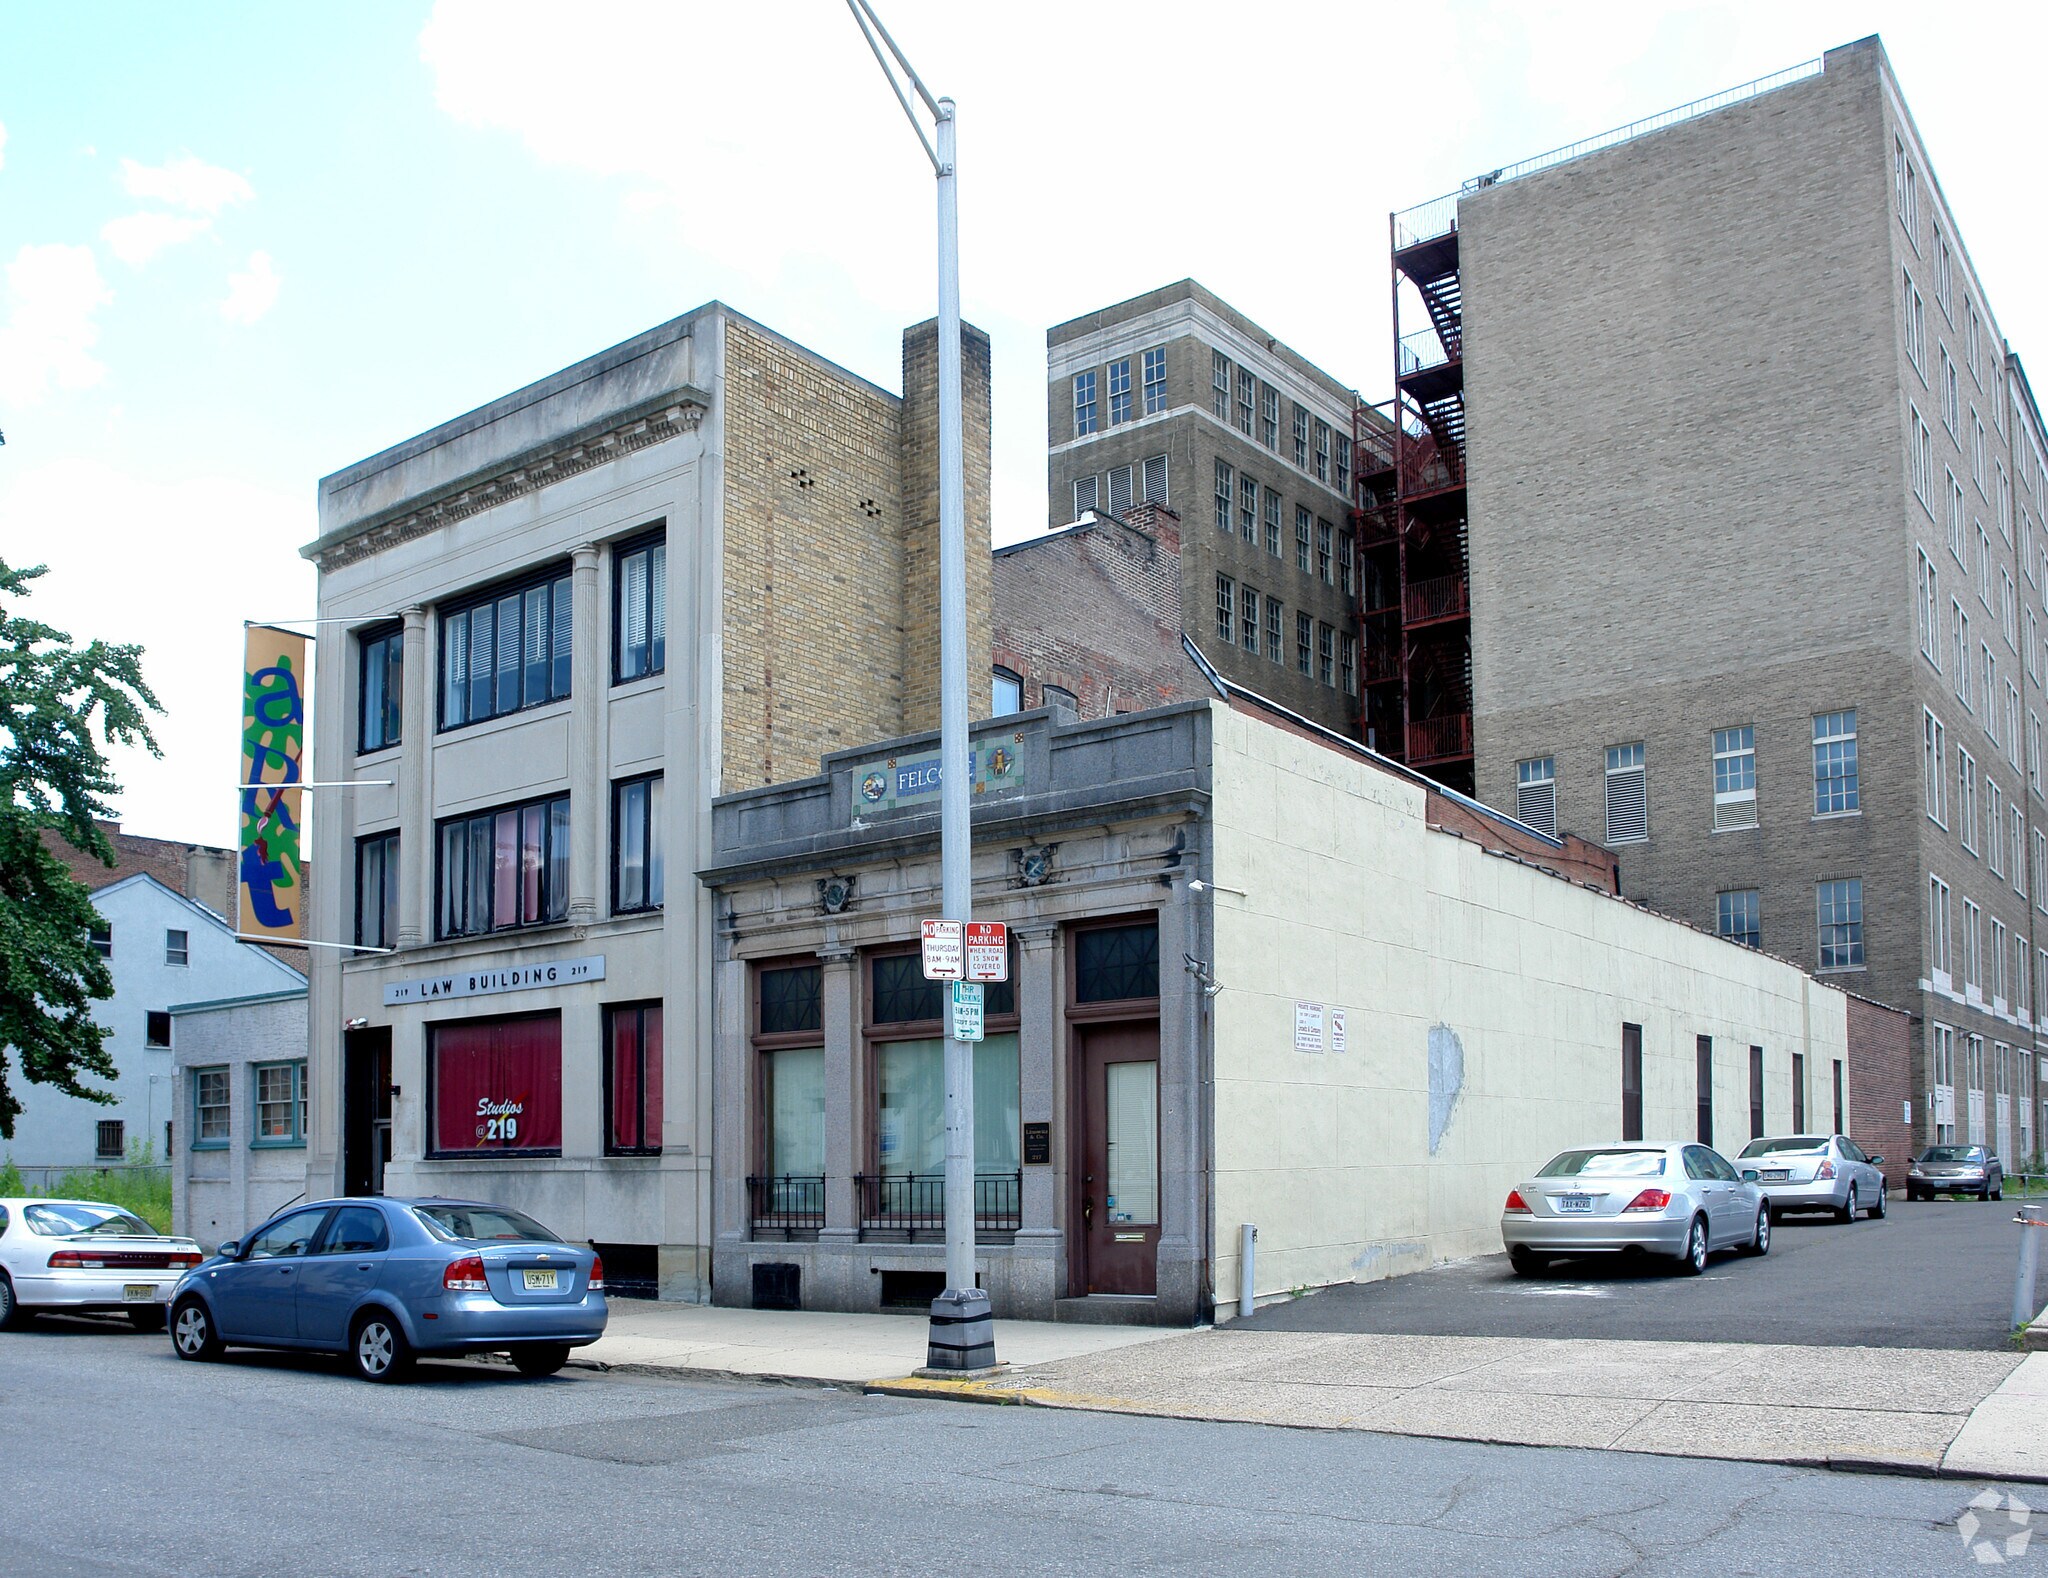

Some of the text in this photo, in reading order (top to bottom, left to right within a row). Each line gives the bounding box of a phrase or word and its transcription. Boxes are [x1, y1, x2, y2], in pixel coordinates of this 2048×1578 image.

[923, 924, 959, 936] NO PARKING
[980, 925, 991, 934] NO
[968, 935, 1004, 945] PARKING
[926, 944, 959, 953] THURSDAY
[395, 966, 588, 997] 219 LAW BUILDING 219
[476, 1097, 523, 1116] Studios
[487, 1118, 517, 1140] 219
